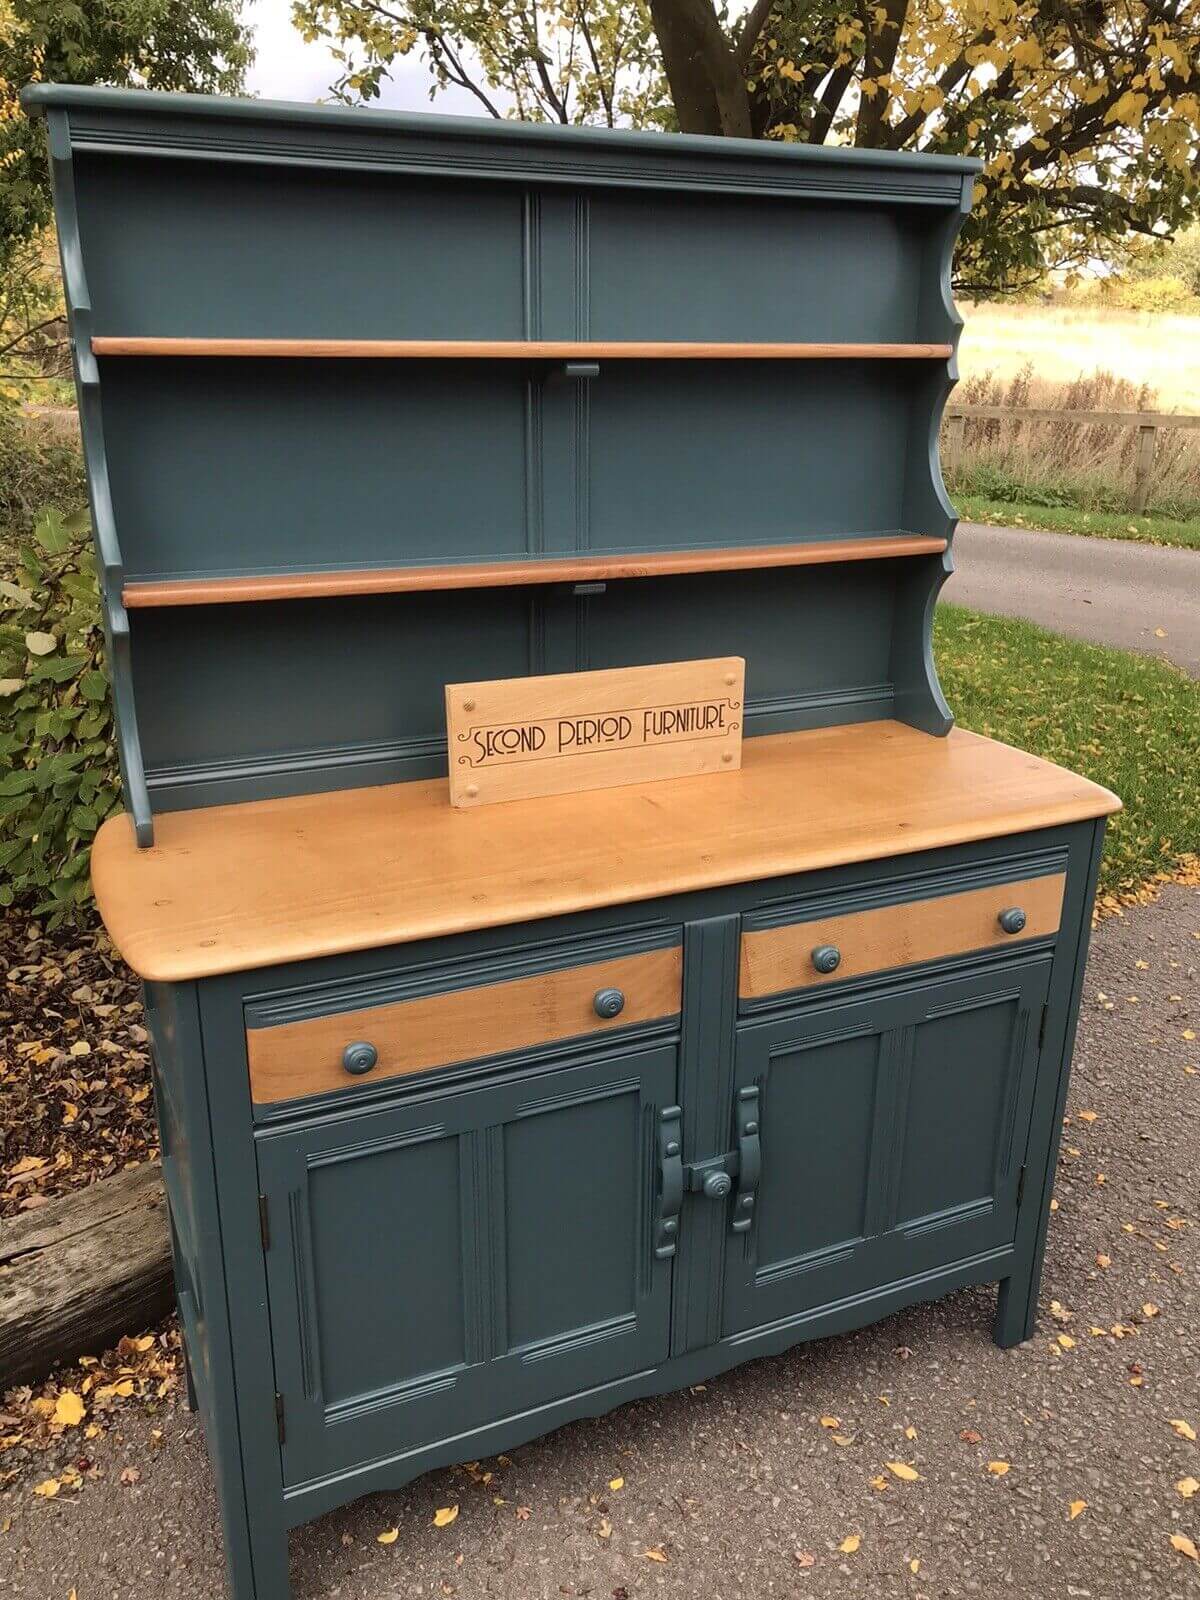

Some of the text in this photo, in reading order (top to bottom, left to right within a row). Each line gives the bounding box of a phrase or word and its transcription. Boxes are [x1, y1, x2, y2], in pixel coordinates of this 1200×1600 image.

[474, 703, 726, 763] SECOND PERIOD FURNITURE
